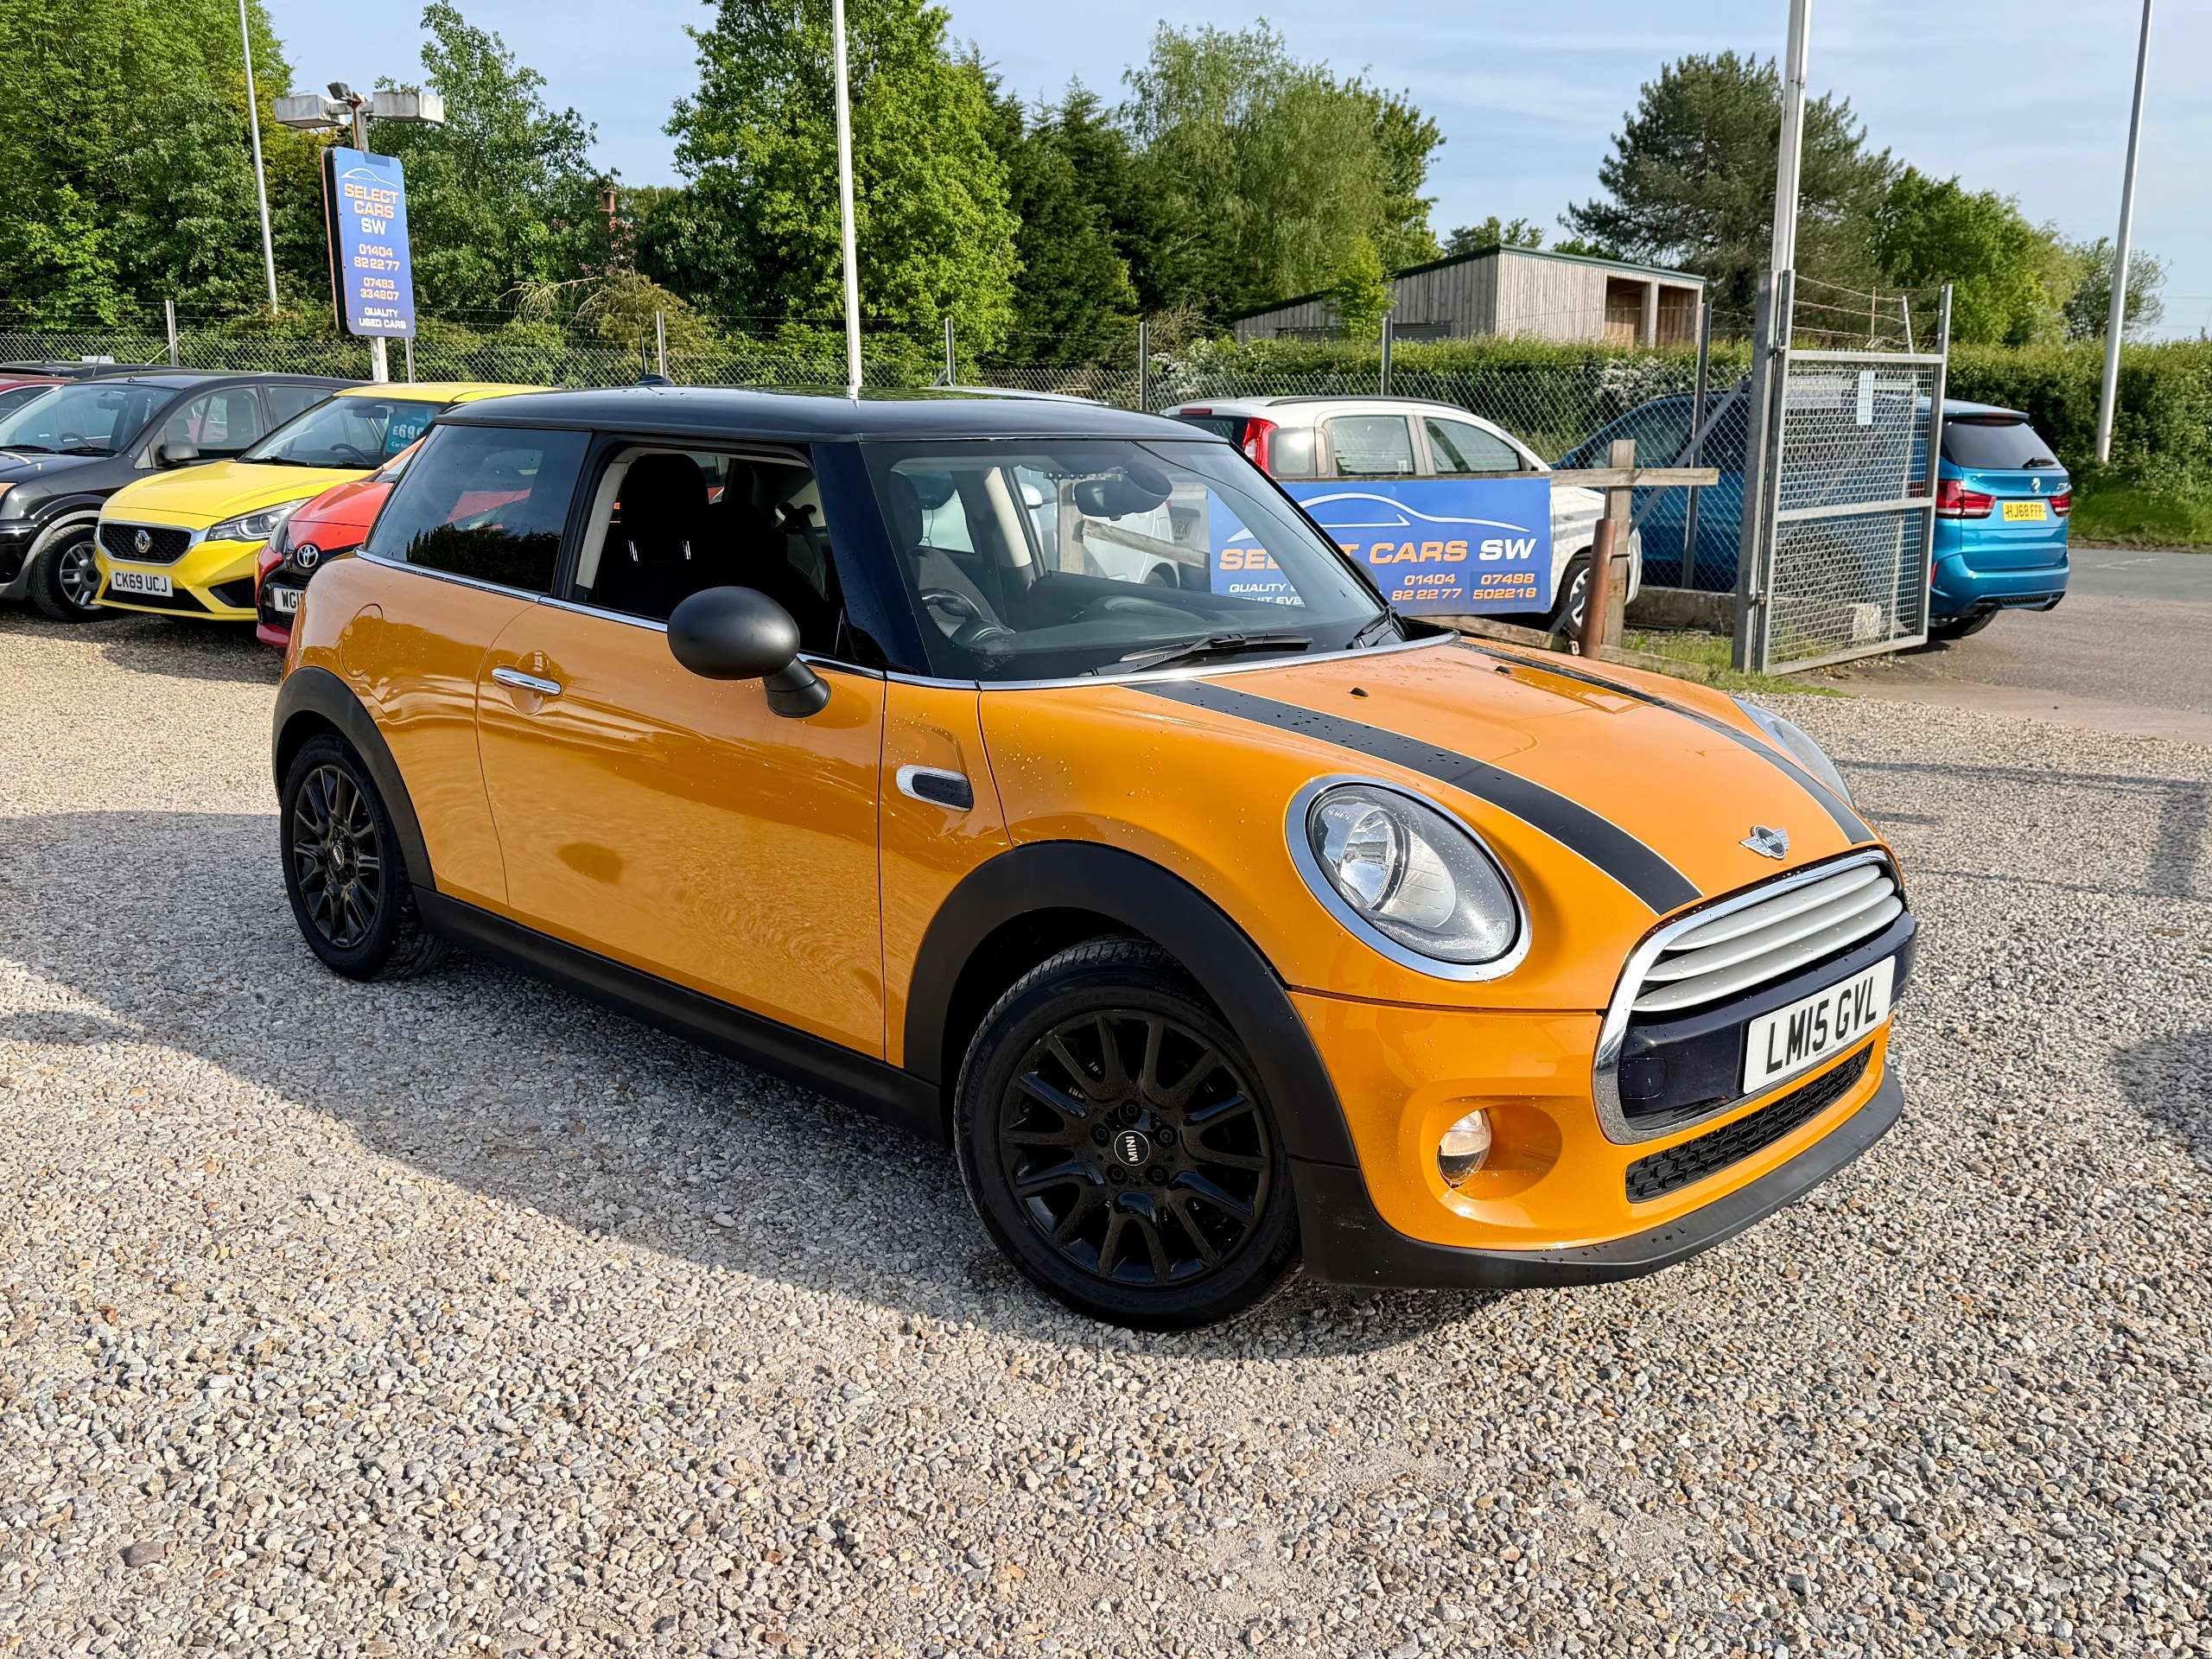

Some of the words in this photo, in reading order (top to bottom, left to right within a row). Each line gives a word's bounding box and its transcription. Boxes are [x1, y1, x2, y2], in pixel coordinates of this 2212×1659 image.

[345, 182, 399, 205] SELECT
[354, 200, 394, 219] CARS
[361, 217, 386, 235] SW
[359, 243, 393, 258] 01404
[359, 288, 399, 301] 334807
[364, 307, 398, 318] QUALITY
[358, 317, 382, 327] USED
[383, 319, 406, 329] CARS
[1369, 540, 1468, 564] CARS
[1478, 538, 1538, 562] SW
[115, 572, 143, 589] CK69
[145, 575, 168, 593] UCJ
[1404, 574, 1457, 586] 01404
[1480, 573, 1535, 586] 07498
[1229, 583, 1287, 593] QUALITY
[1391, 590, 1414, 601] 82
[1415, 588, 1439, 601] 22
[1440, 588, 1463, 600] 77
[1472, 587, 1537, 600] 502218
[1765, 999, 1830, 1074] LM15
[1834, 976, 1878, 1040] GVL
[1125, 1135, 1139, 1162] MINI
